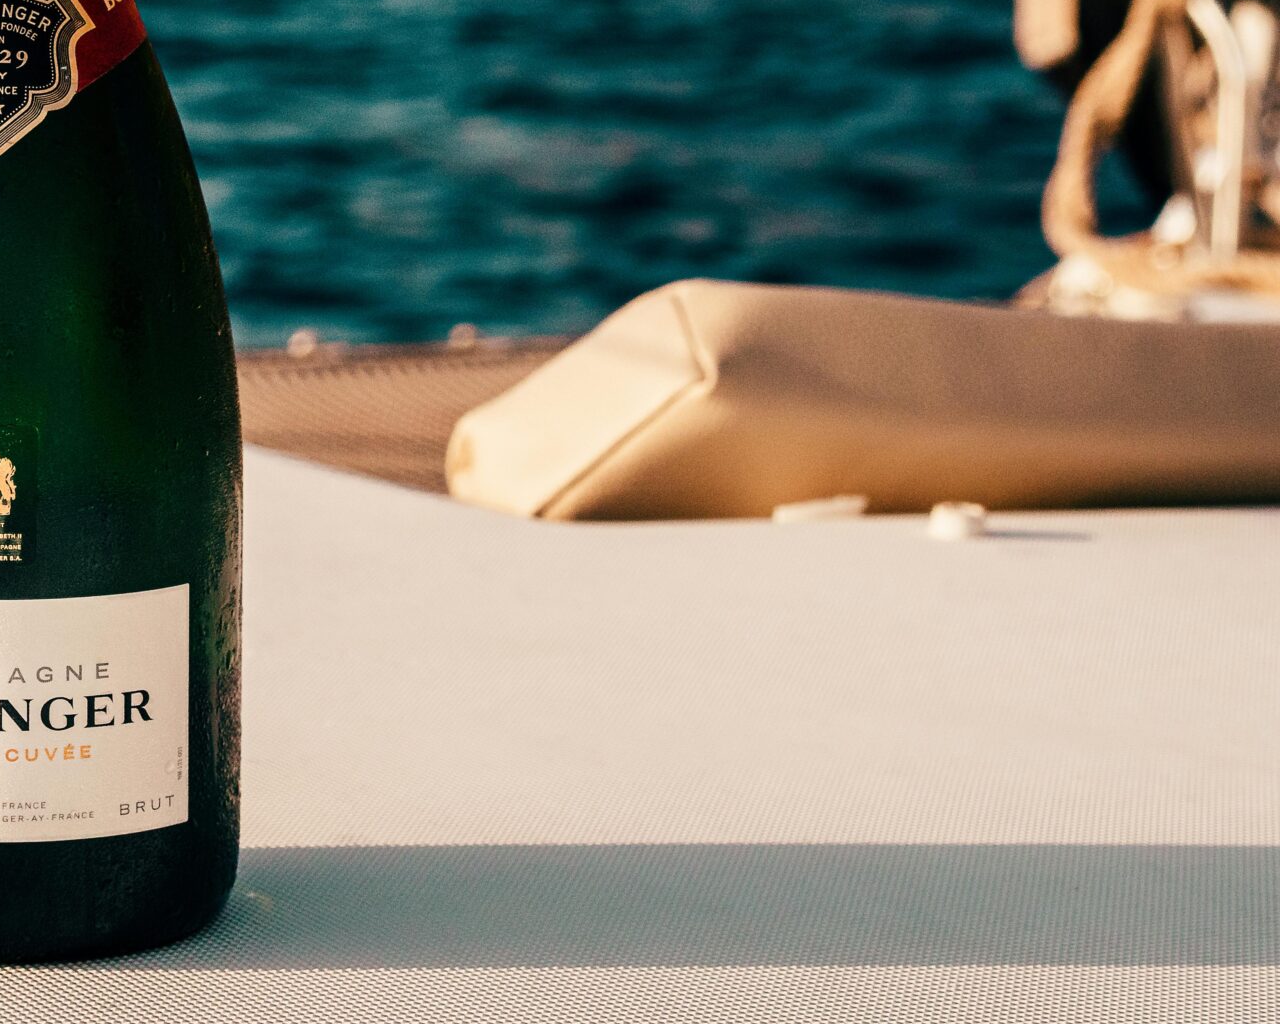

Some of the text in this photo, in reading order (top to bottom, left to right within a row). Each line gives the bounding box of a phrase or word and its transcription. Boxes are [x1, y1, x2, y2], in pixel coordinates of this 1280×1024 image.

[0, 21, 38, 42] FONDÉE
[5, 744, 93, 763] CUVÉE
[2, 801, 47, 810] FRANCE
[119, 794, 175, 816] BRUT
